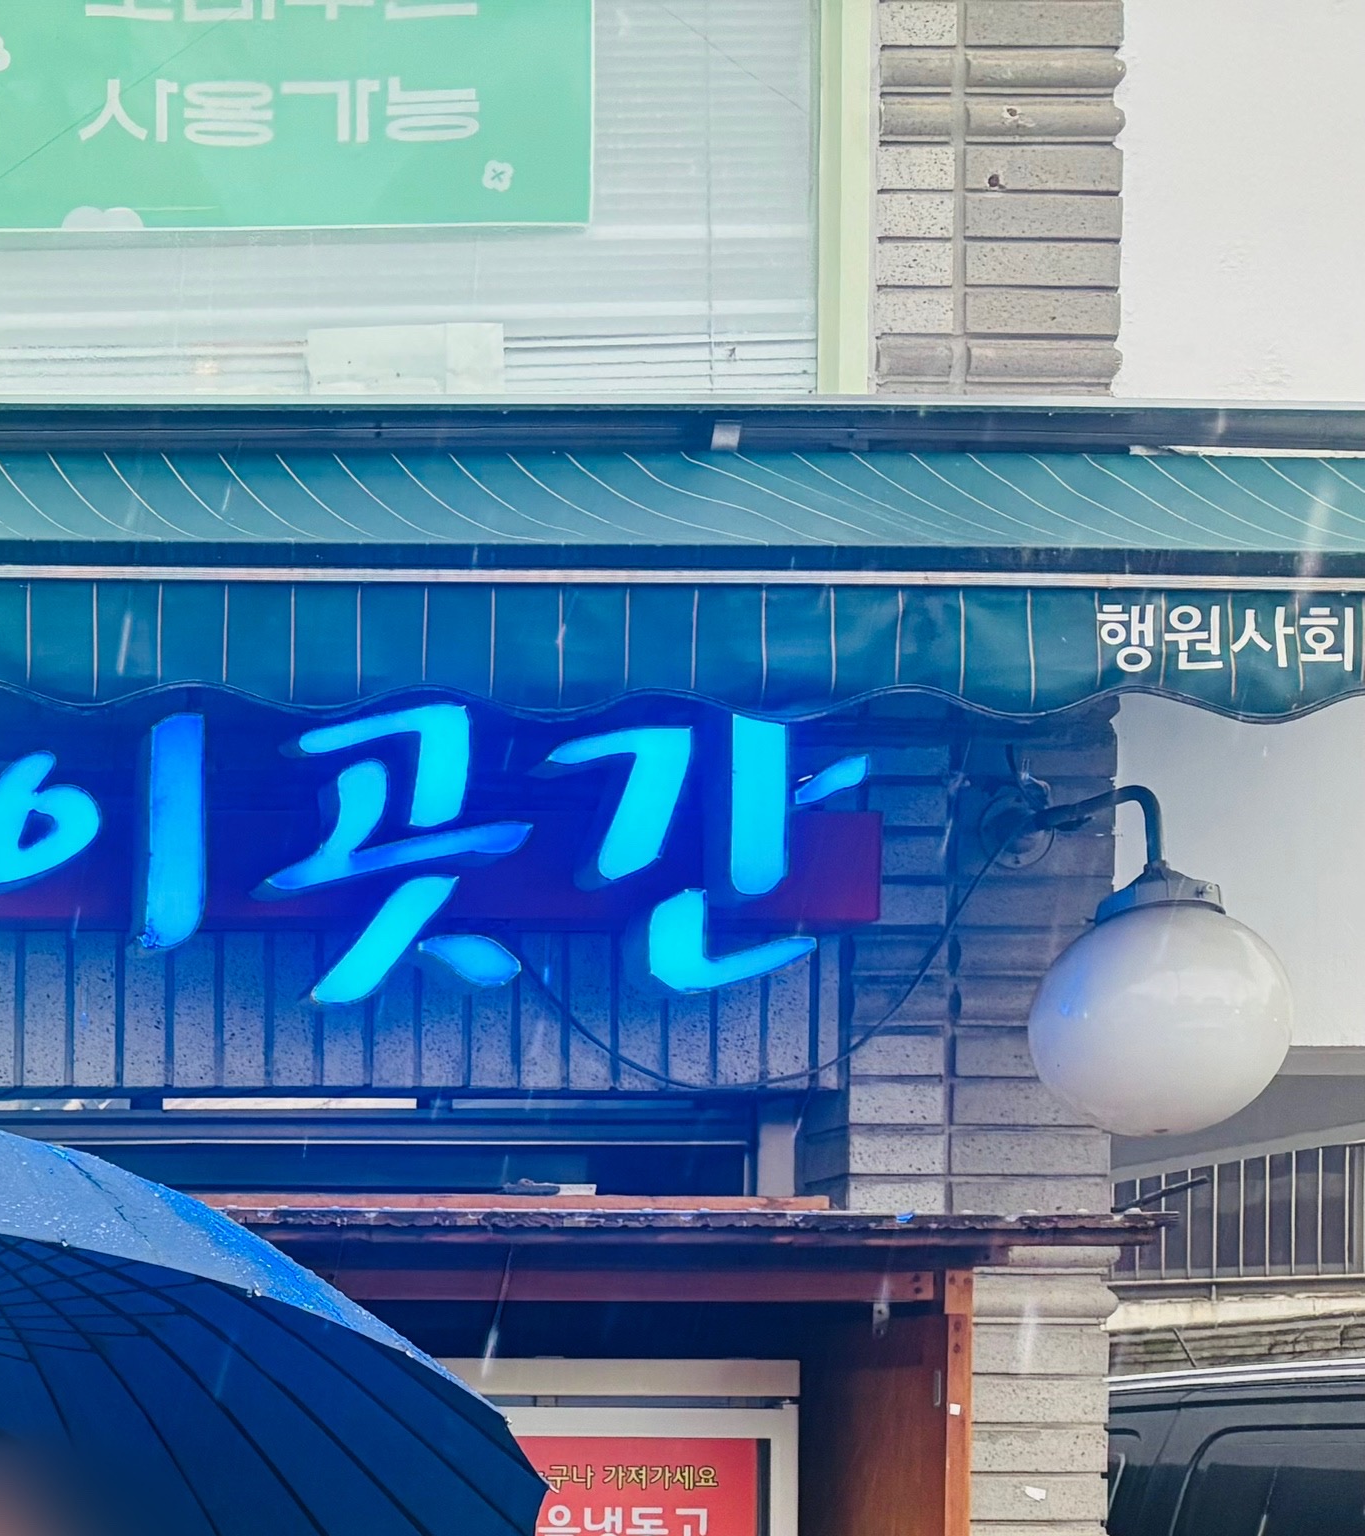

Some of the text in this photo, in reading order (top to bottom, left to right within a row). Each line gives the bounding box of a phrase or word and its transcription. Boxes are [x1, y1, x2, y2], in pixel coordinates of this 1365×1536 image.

[78, 77, 481, 147] 사용가능
[1096, 603, 1354, 673] 행원사회
[539, 1464, 719, 1491] 구나 가져가세요
